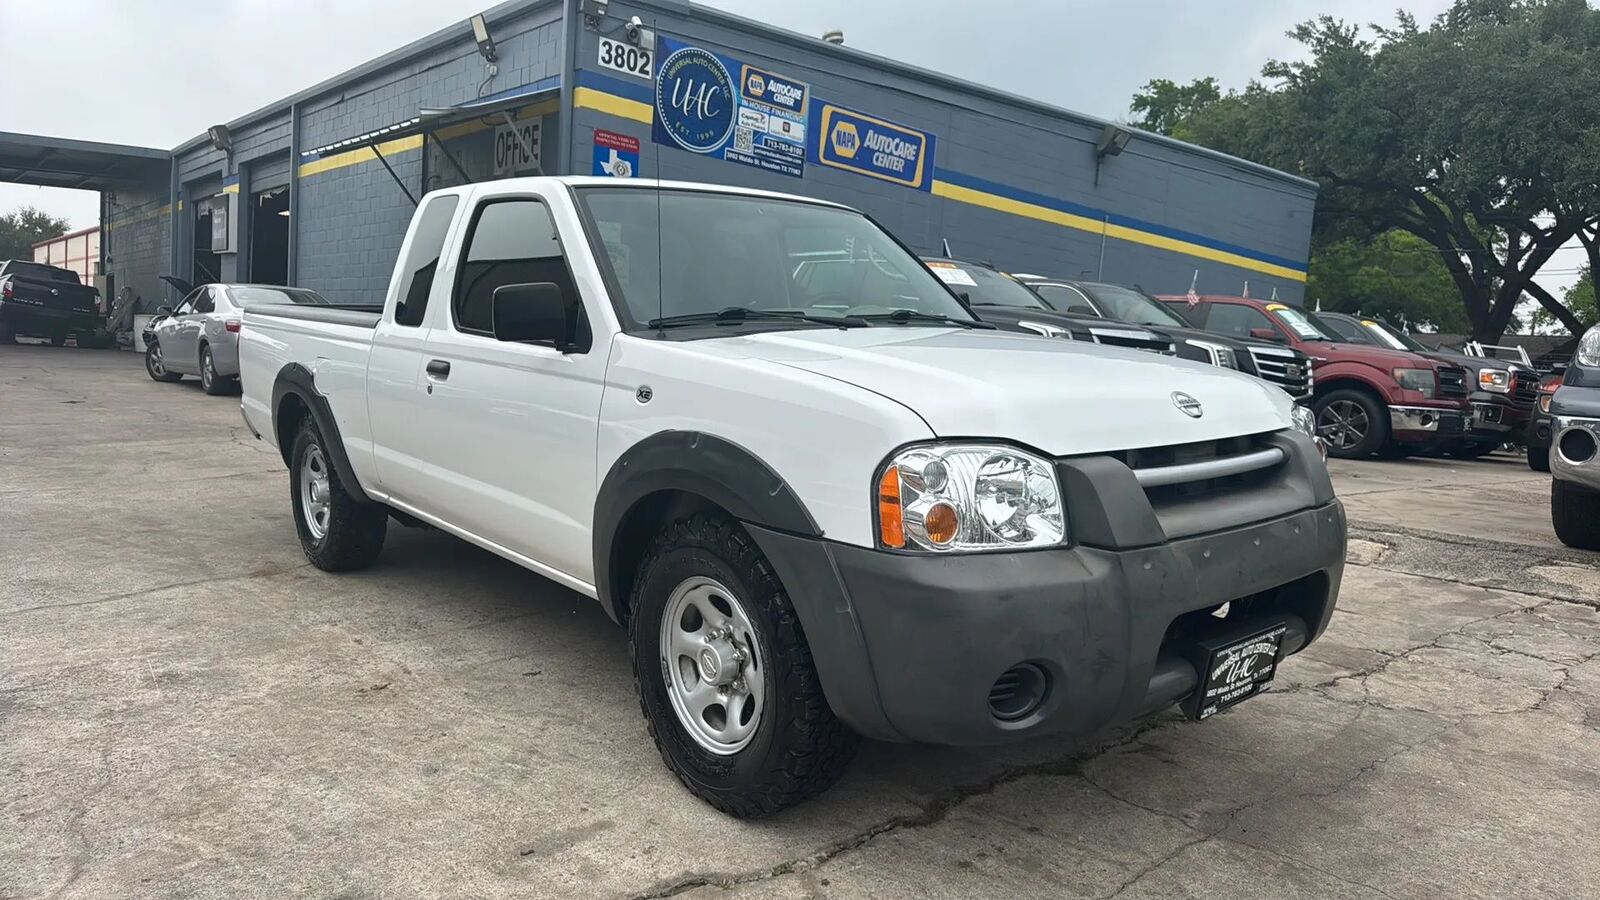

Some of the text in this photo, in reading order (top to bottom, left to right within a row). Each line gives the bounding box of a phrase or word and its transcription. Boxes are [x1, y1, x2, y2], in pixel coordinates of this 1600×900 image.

[601, 40, 650, 76] 3802
[667, 58, 693, 80] UNIVERSAL
[693, 57, 708, 68] AUTO
[707, 63, 726, 85] CENTER
[751, 79, 763, 90] NAPA
[672, 77, 720, 120] UAC
[741, 99, 750, 107] IN
[749, 101, 771, 114] HOUSE
[773, 93, 795, 107] CENTER
[496, 124, 539, 169] OFFICE
[767, 140, 803, 155] 713-783-8100
[836, 130, 855, 150] NAPA
[872, 151, 905, 173] CENTER
[638, 389, 651, 400] XE
[1226, 654, 1258, 684] UAC
